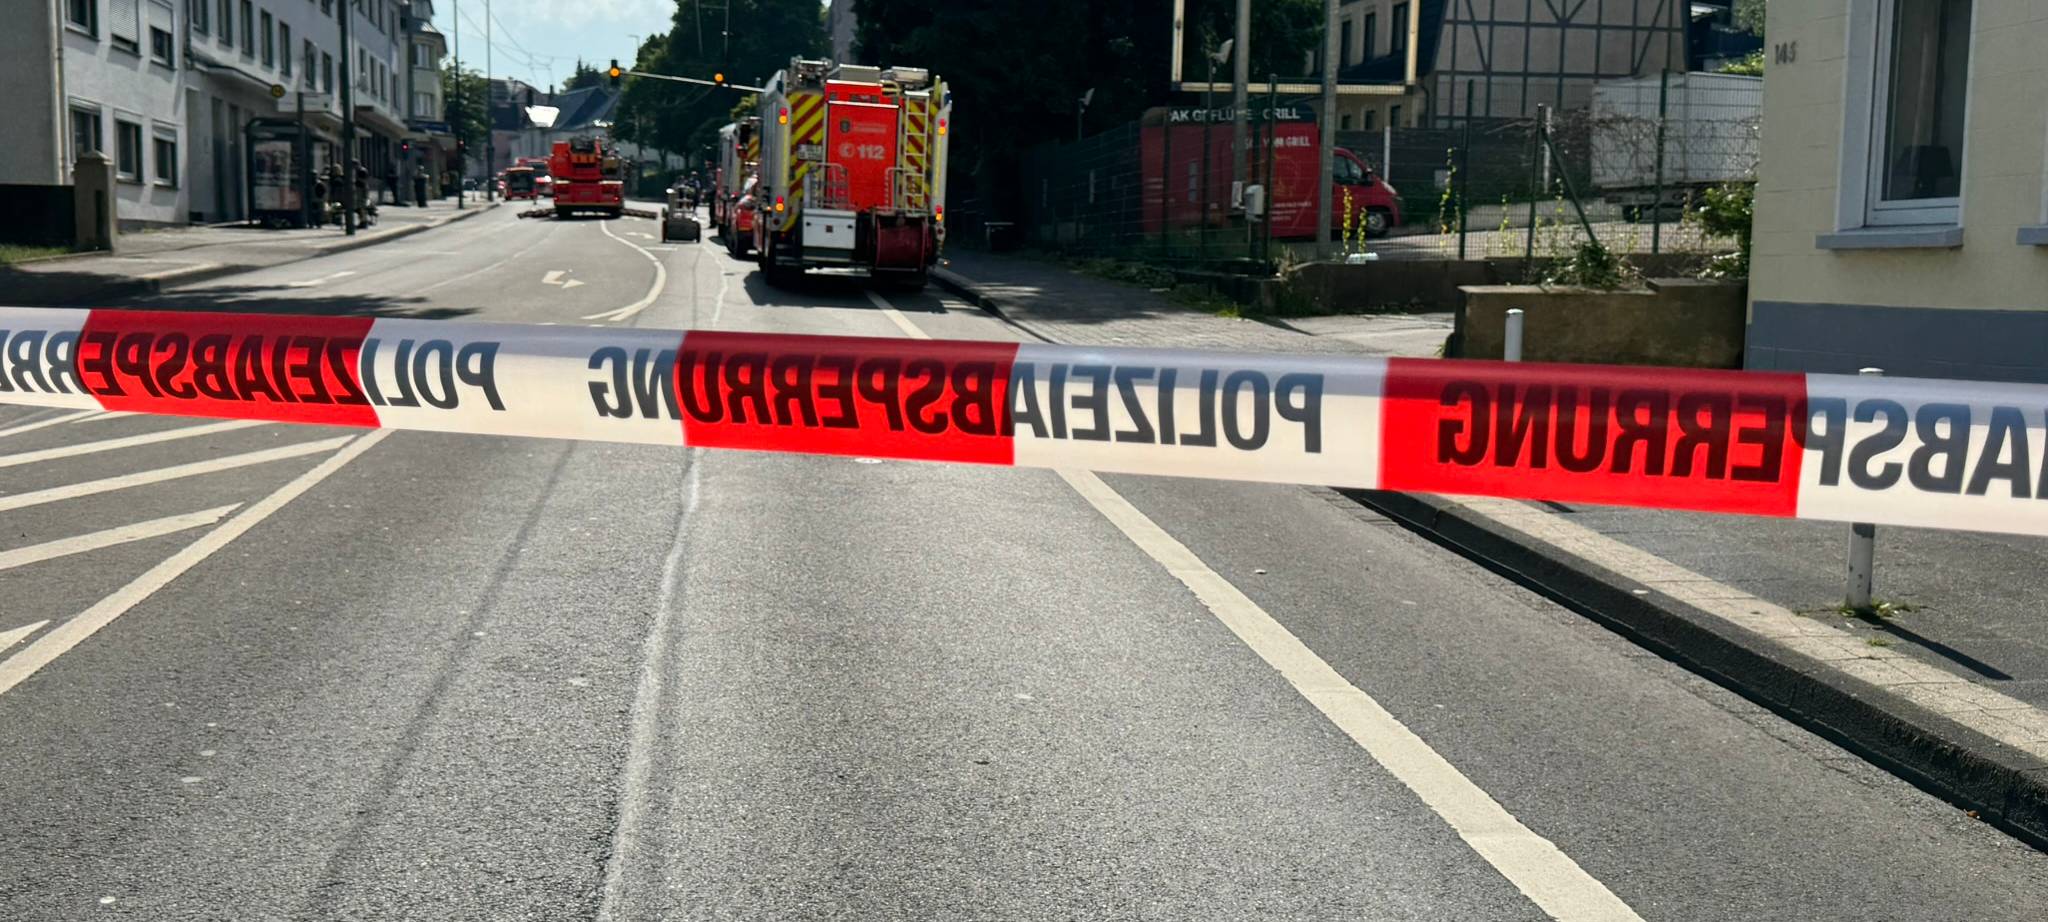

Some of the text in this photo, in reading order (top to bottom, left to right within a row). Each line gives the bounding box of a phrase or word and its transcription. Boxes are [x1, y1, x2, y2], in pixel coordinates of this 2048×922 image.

[1775, 41, 1797, 65] 145
[1169, 108, 1190, 122] AK
[857, 143, 885, 160] 112
